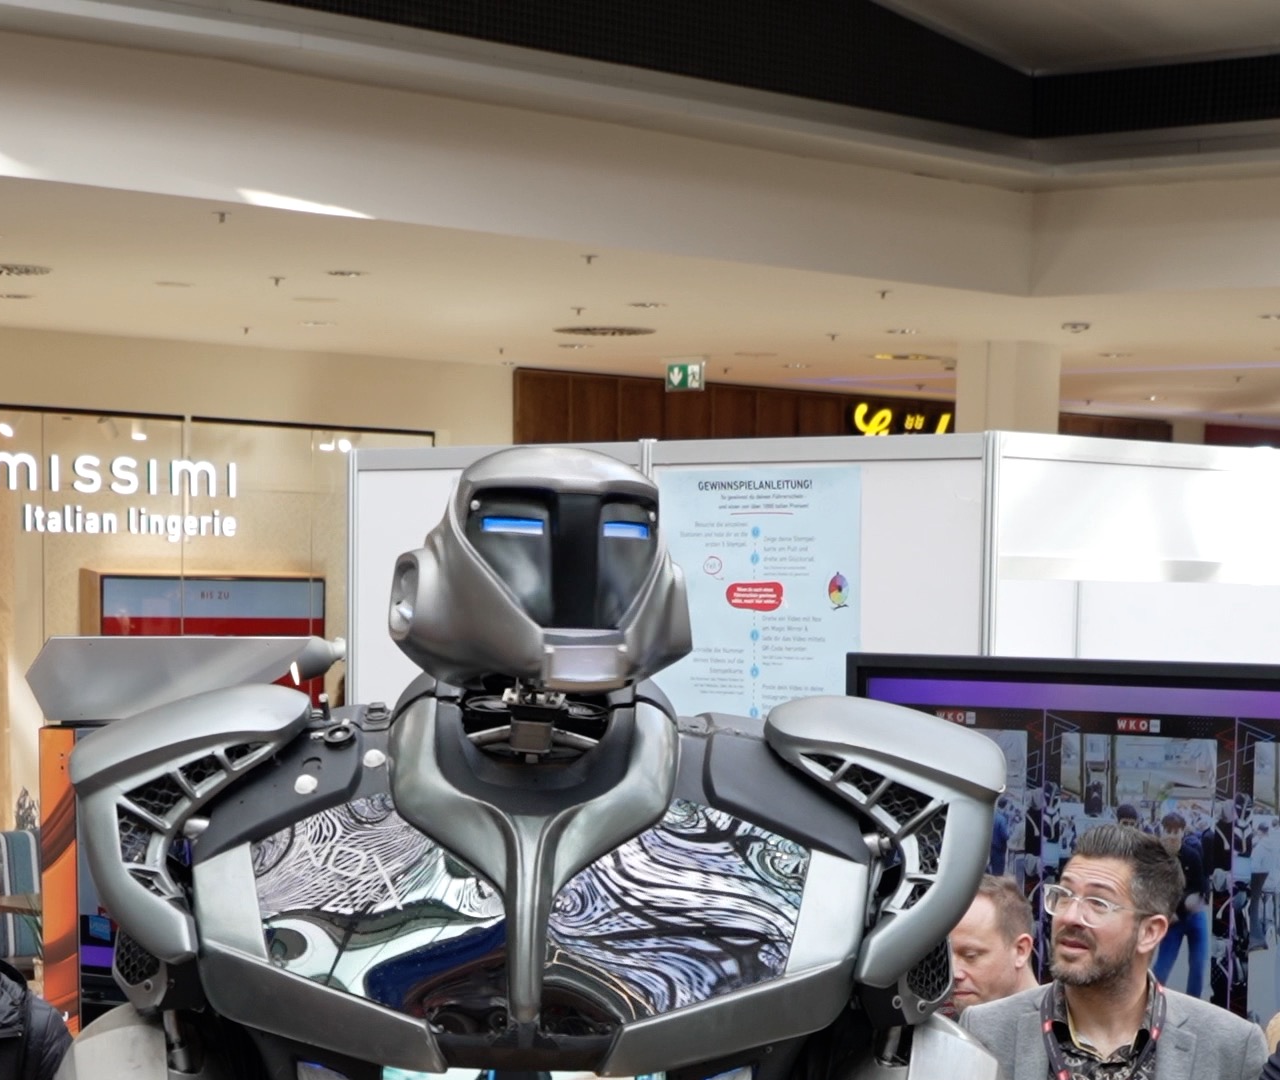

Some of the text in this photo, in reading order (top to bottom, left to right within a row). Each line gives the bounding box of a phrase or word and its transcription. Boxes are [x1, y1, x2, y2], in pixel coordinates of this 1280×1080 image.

[698, 479, 813, 491] GEWINNSPIELANLEITUNG!
[24, 504, 237, 542] Italian lingerie
[217, 591, 230, 600] ZU
[1116, 719, 1148, 731] WKO
